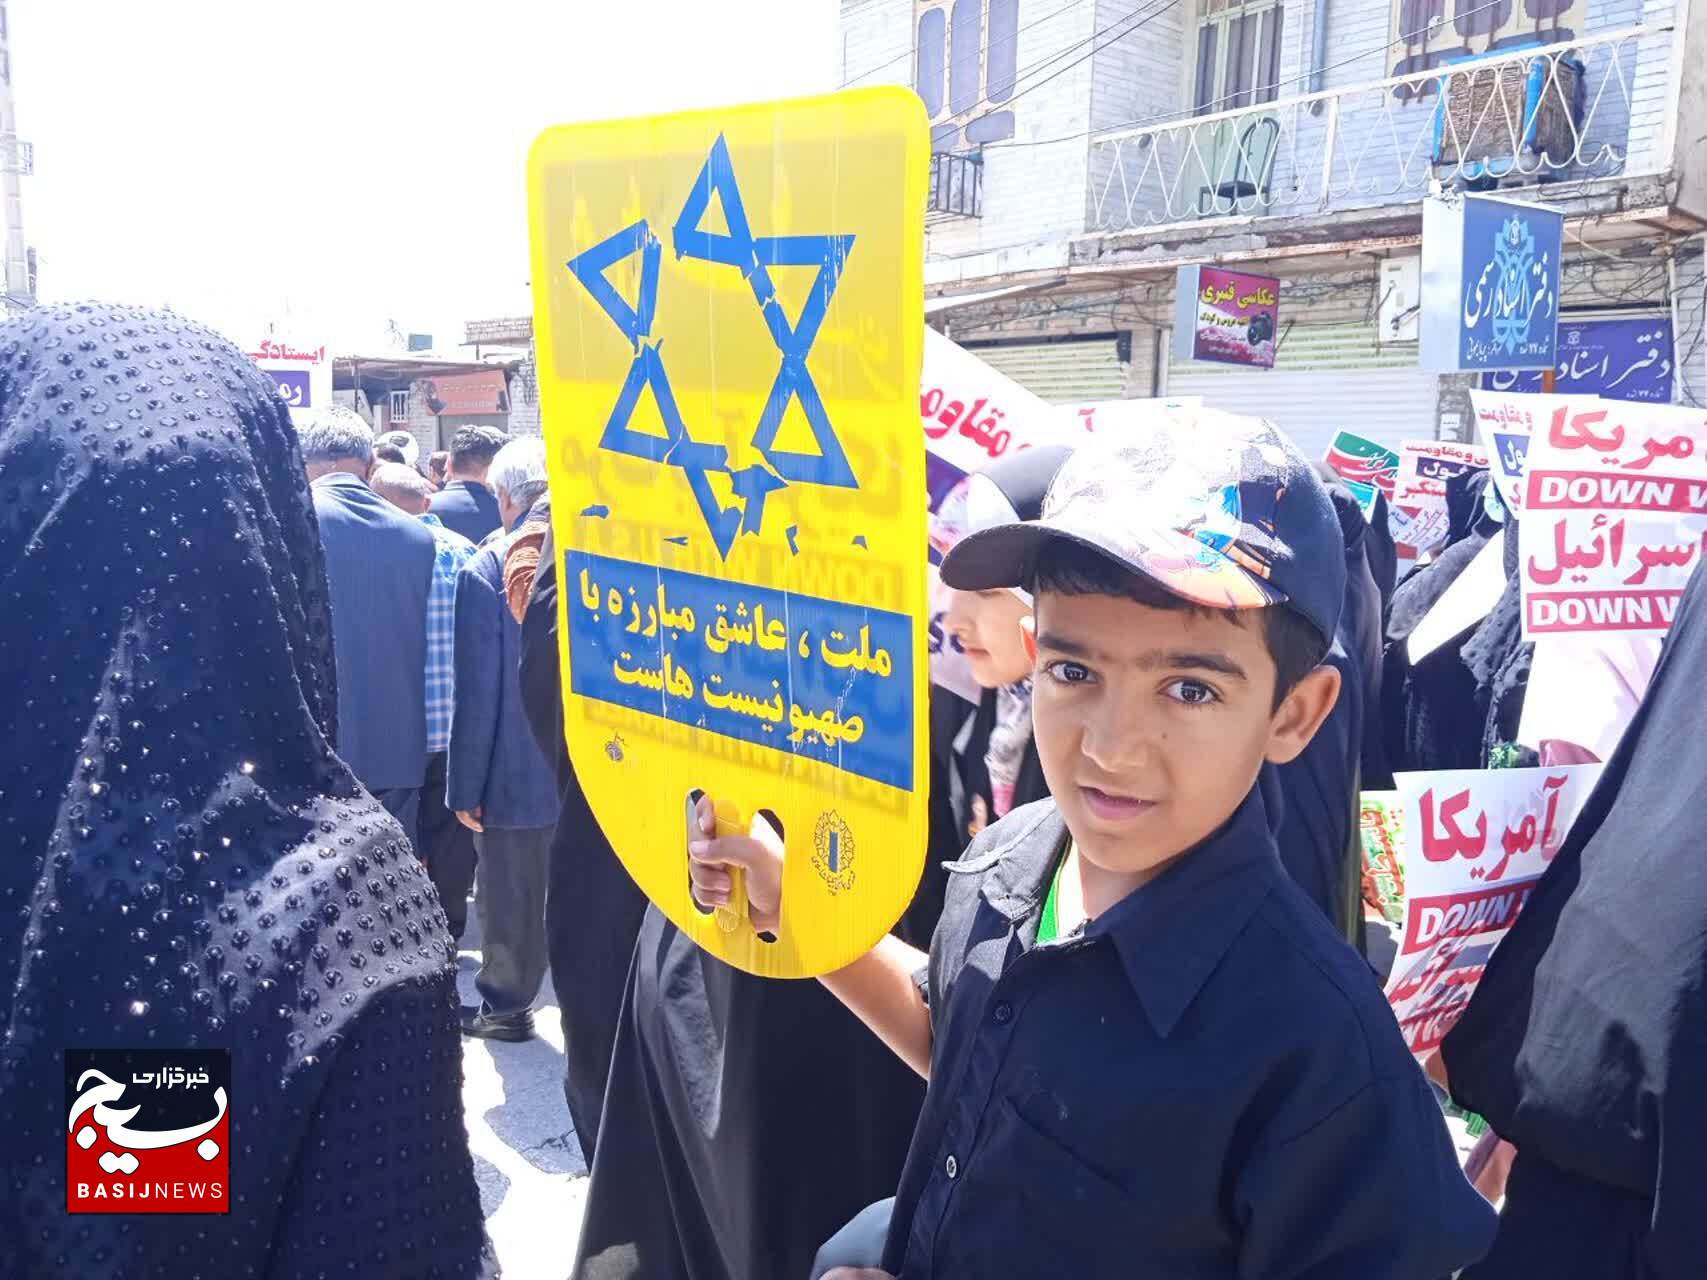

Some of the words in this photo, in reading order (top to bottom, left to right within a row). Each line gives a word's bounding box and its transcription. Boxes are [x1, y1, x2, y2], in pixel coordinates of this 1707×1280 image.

[1237, 288, 1276, 308] عکاسی
[1555, 351, 1608, 381] اسناد
[1606, 330, 1671, 389] دفتر
[921, 388, 1011, 458] مقاوم
[1549, 405, 1707, 470] مریکا
[1540, 477, 1674, 506] DOWN
[1528, 514, 1707, 586] سرائیل
[579, 568, 600, 623] با
[607, 584, 696, 640] مبارزه
[1531, 597, 1652, 627] DOWN
[704, 601, 787, 653] عاشق
[820, 625, 892, 677] ملت
[612, 650, 693, 700] هاست
[1418, 774, 1569, 882] آمریکا
[1415, 891, 1516, 944] DOWN
